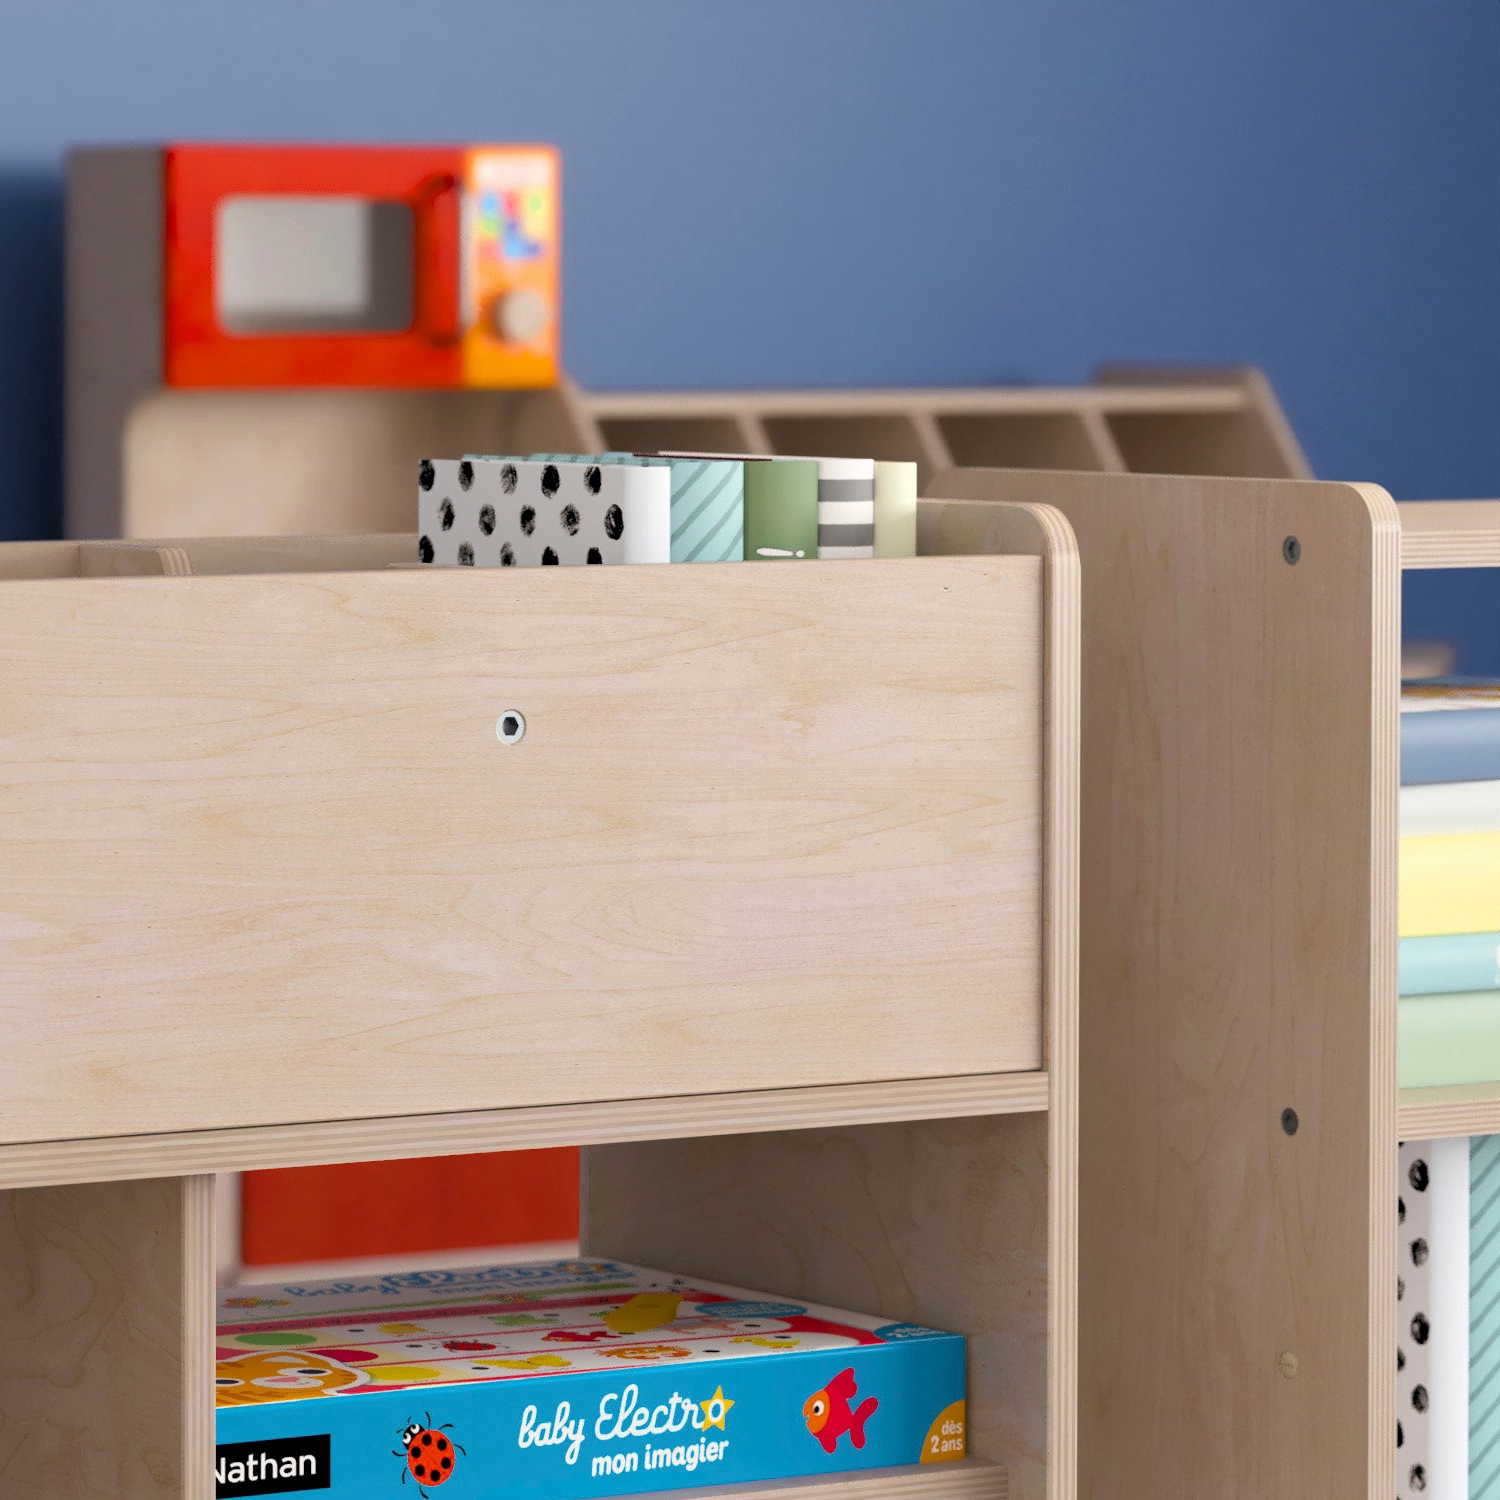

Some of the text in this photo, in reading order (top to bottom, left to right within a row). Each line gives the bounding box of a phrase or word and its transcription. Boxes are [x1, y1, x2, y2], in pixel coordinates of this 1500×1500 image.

[518, 1384, 725, 1466] baby Electro
[941, 1419, 964, 1435] dès
[592, 1437, 730, 1477] mon imagier
[931, 1435, 964, 1453] 2 ans
